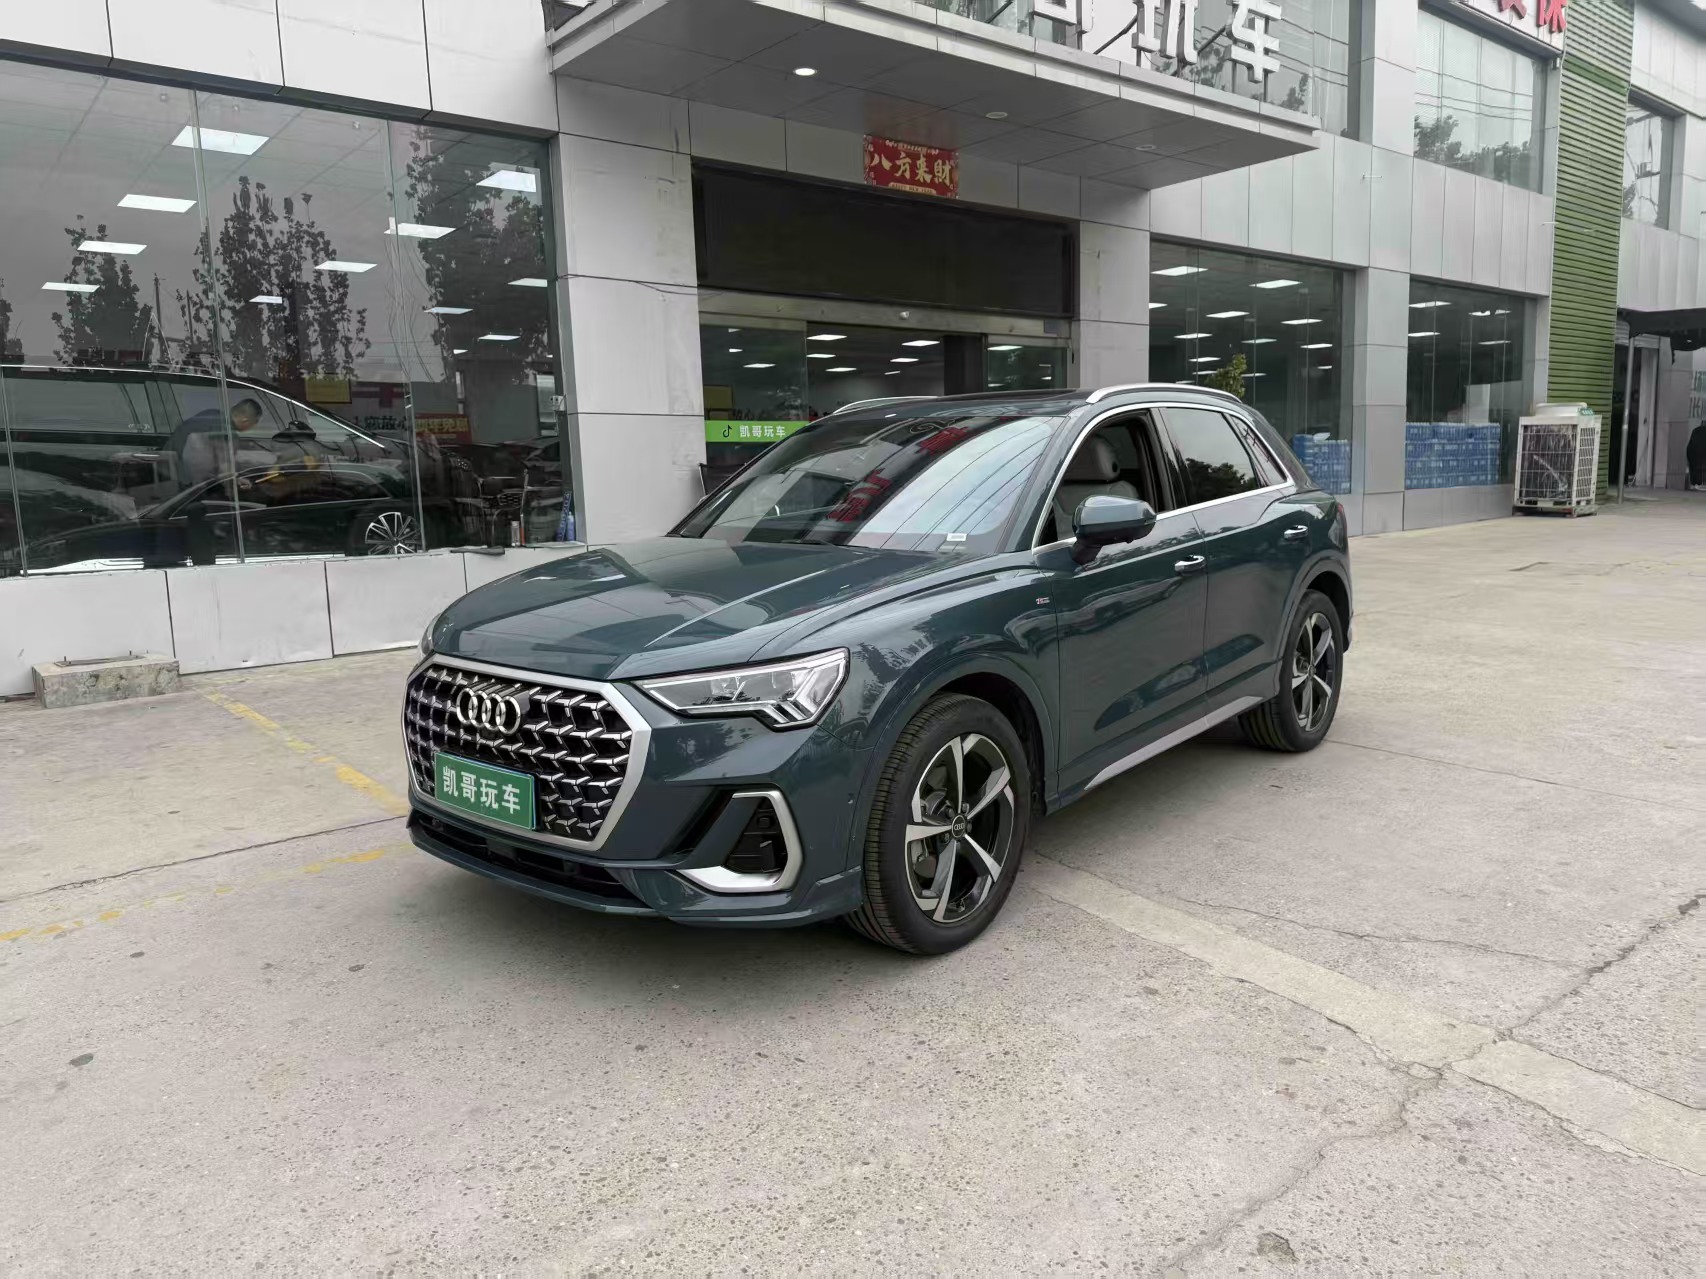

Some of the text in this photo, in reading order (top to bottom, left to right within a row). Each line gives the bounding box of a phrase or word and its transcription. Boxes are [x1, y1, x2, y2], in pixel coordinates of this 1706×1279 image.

[740, 425, 786, 438] 凯哥玩车
[442, 765, 521, 815] 凯哥玩车
